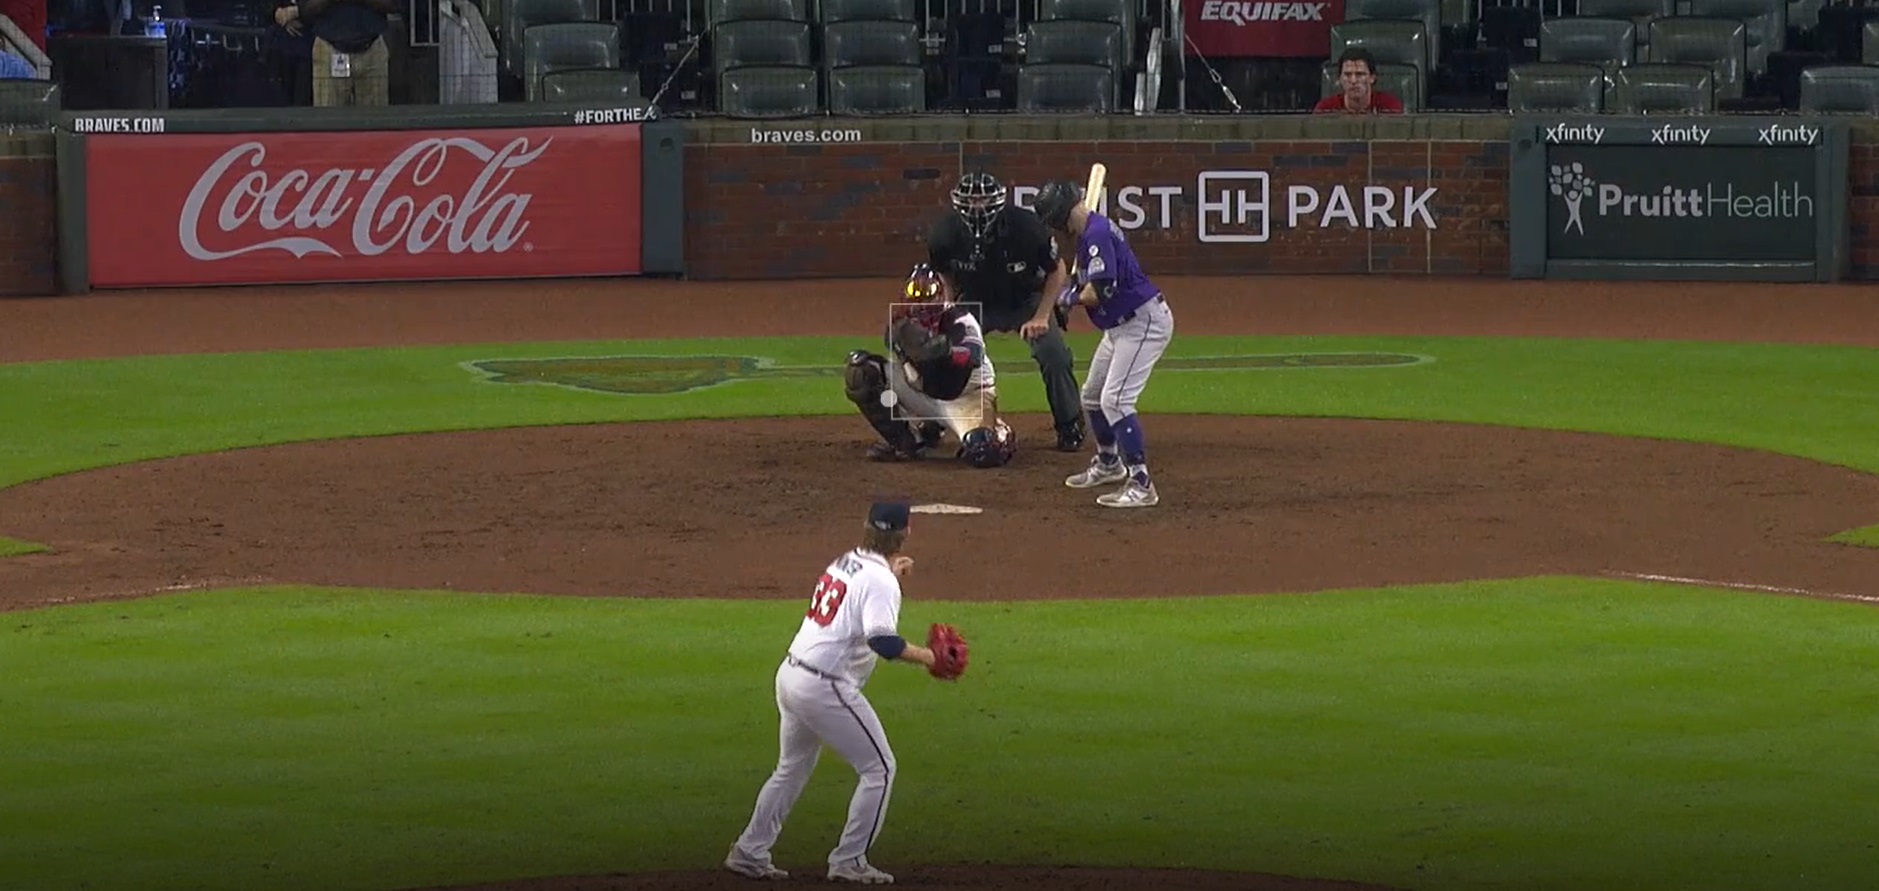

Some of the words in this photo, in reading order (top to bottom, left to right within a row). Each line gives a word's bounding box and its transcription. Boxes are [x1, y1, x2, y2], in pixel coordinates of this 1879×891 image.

[1200, 0, 1324, 26] EQUIFAX
[74, 118, 165, 133] BRAVES.COM
[751, 127, 862, 143] braves.com
[1546, 123, 1605, 145] xfinity
[1651, 124, 1711, 145] xfinity
[1758, 124, 1819, 145] xfinity
[178, 135, 554, 261] Coca-Cola
[1288, 185, 1439, 230] PARK
[1598, 180, 1814, 218] PruittHealth
